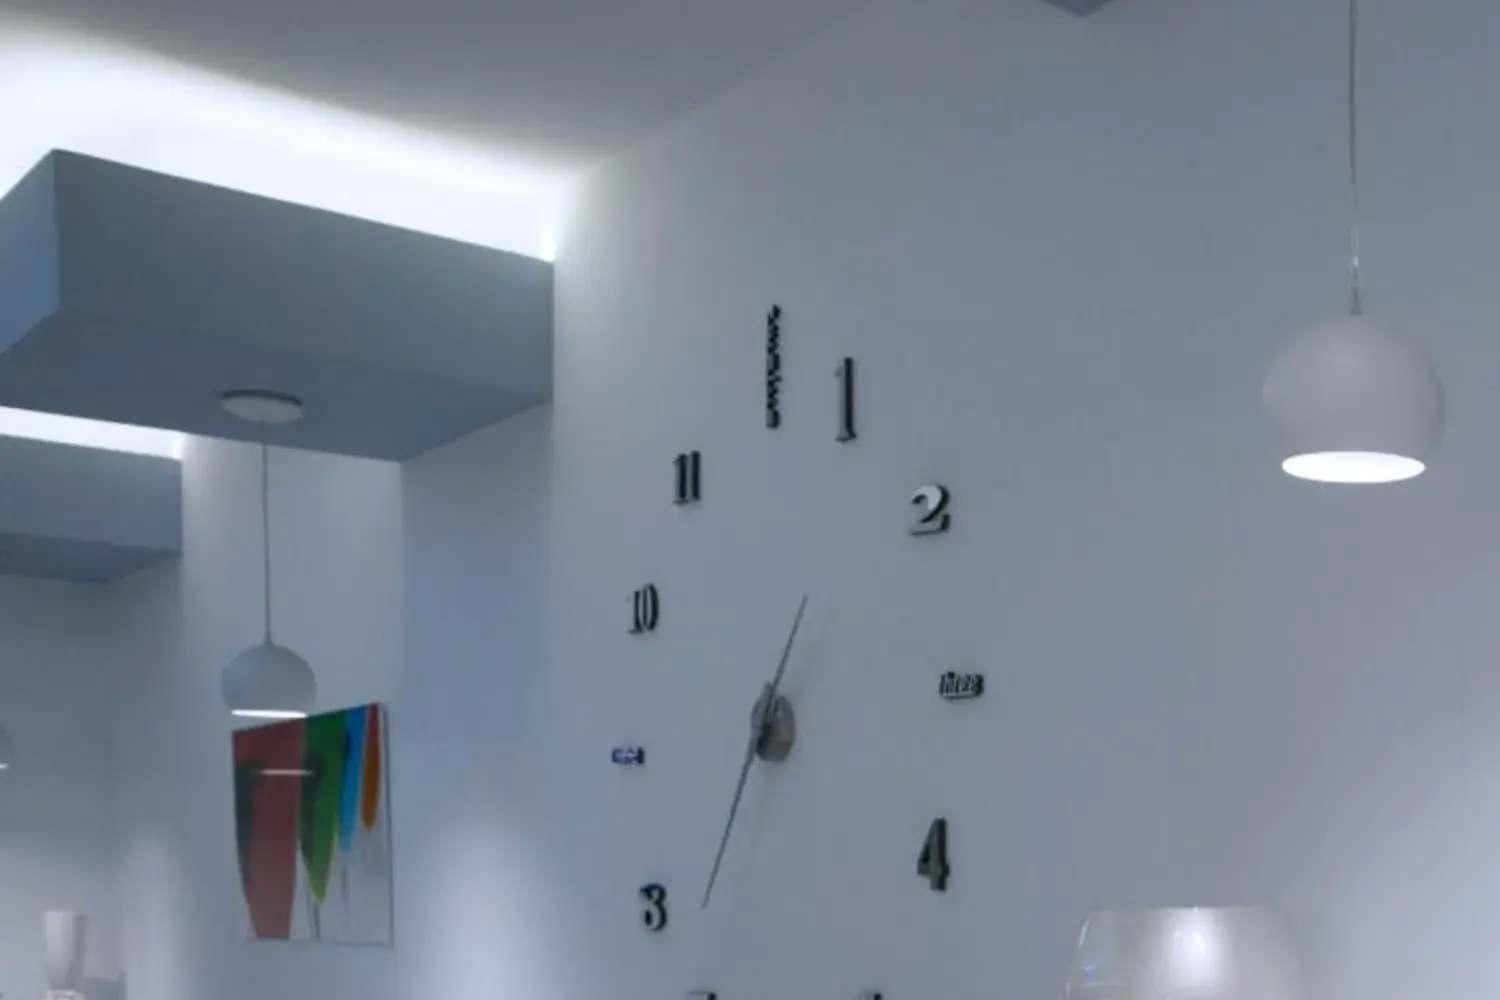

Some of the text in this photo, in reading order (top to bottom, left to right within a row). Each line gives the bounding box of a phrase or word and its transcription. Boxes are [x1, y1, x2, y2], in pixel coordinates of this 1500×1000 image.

[834, 356, 858, 444] 1
[672, 449, 702, 507] 11
[910, 483, 951, 538] 2
[626, 582, 660, 636] 10
[915, 816, 951, 893] 4
